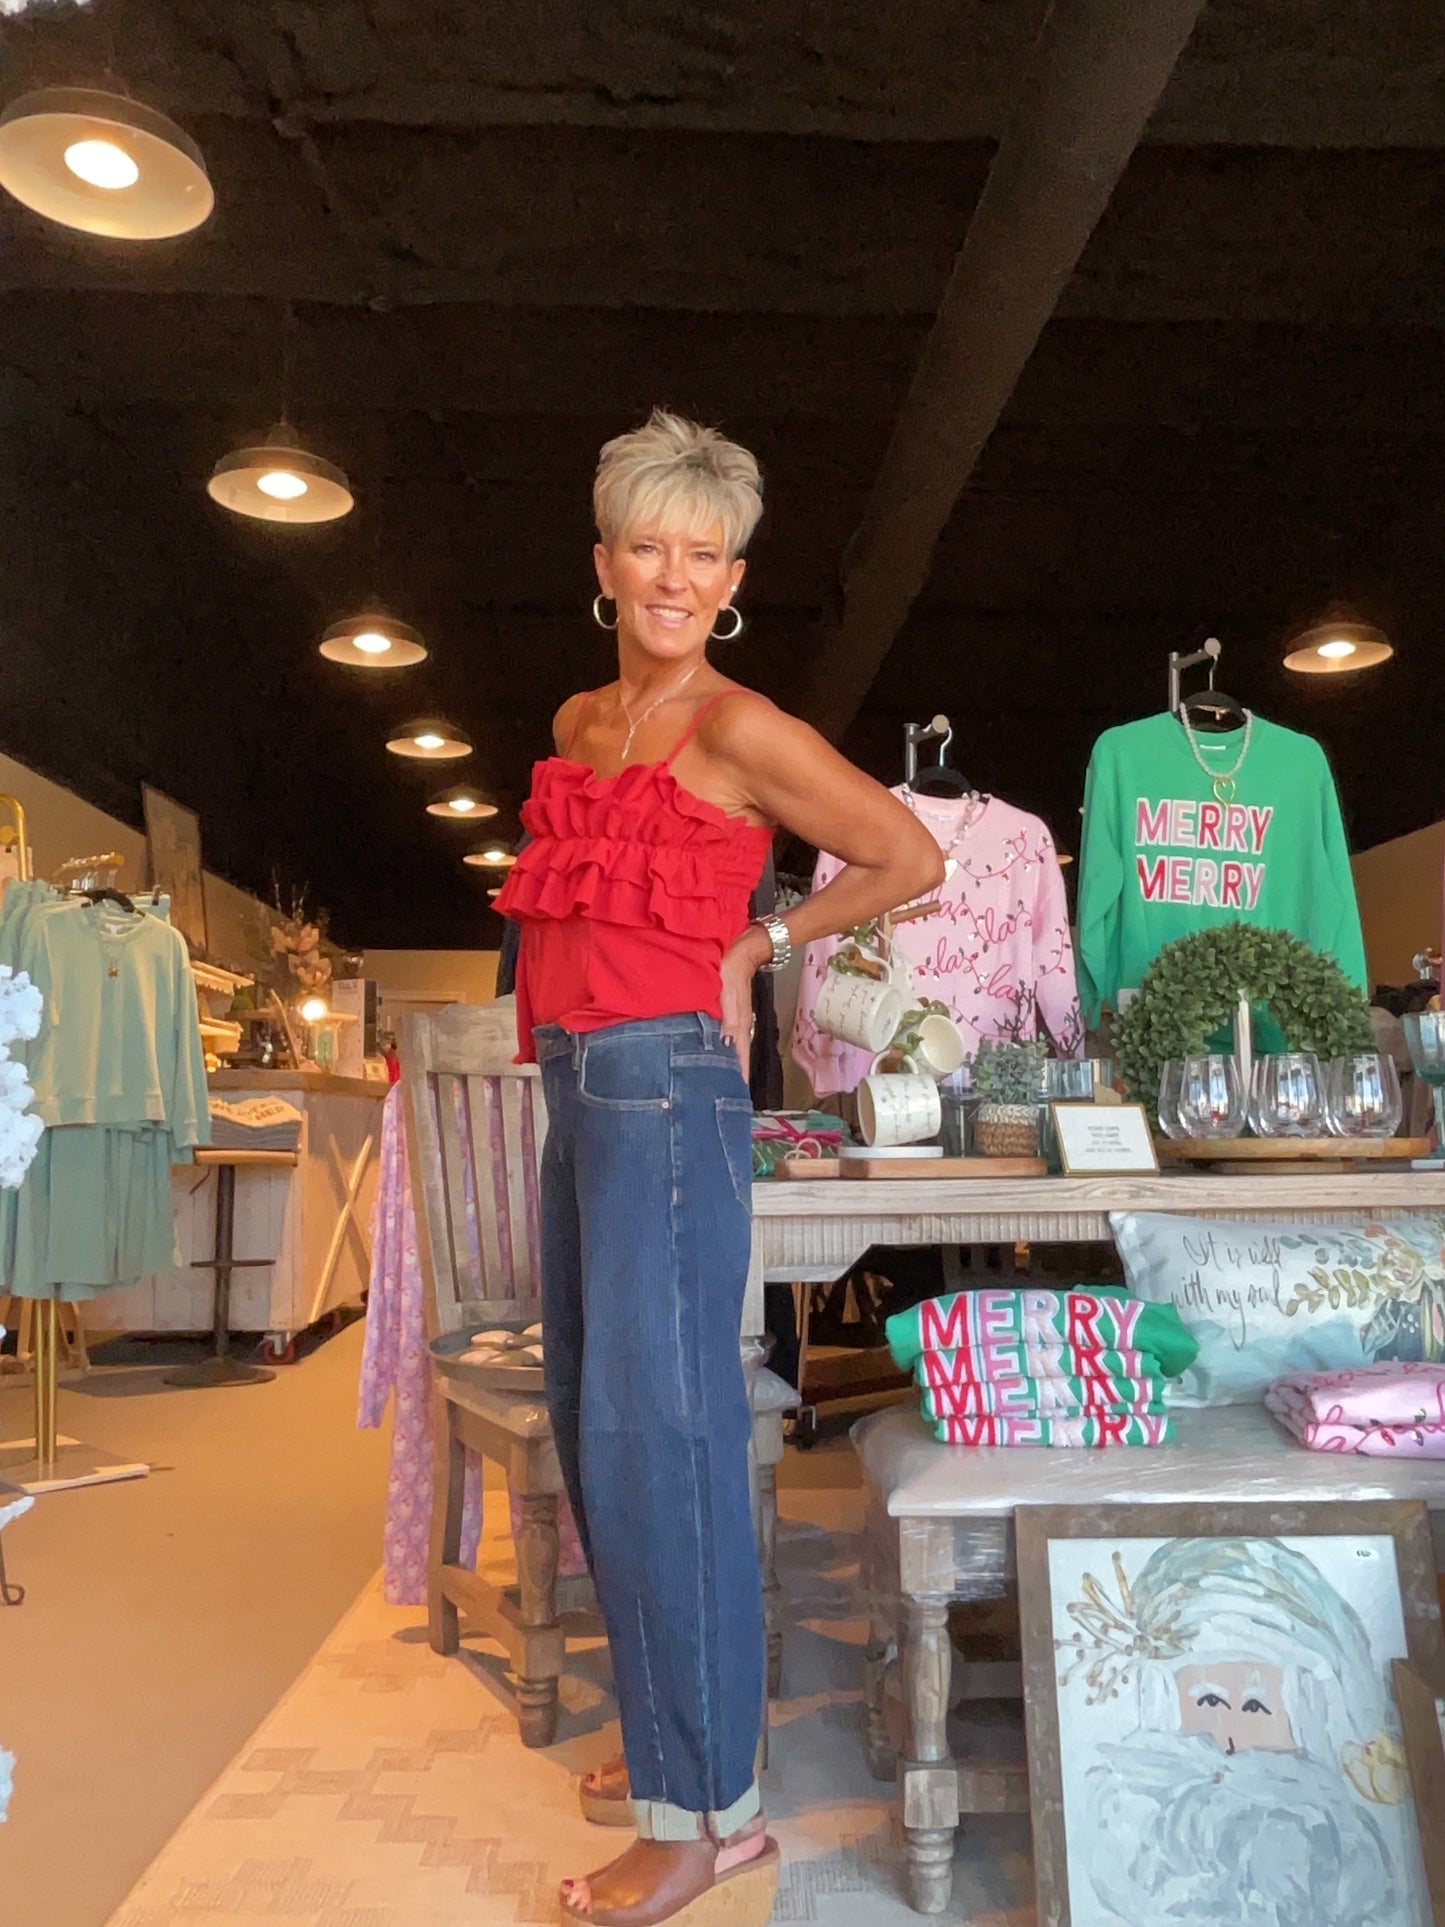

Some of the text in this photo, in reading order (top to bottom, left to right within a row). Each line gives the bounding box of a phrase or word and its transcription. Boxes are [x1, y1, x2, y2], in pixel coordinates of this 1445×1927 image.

[1135, 797, 1274, 855] MERRY
[1136, 854, 1266, 911] MERRY
[984, 906, 1018, 945] la
[936, 935, 1016, 1000] la la
[1223, 1241, 1242, 1270] is
[919, 1289, 1144, 1351] MERRY
[1214, 1289, 1247, 1352] my
